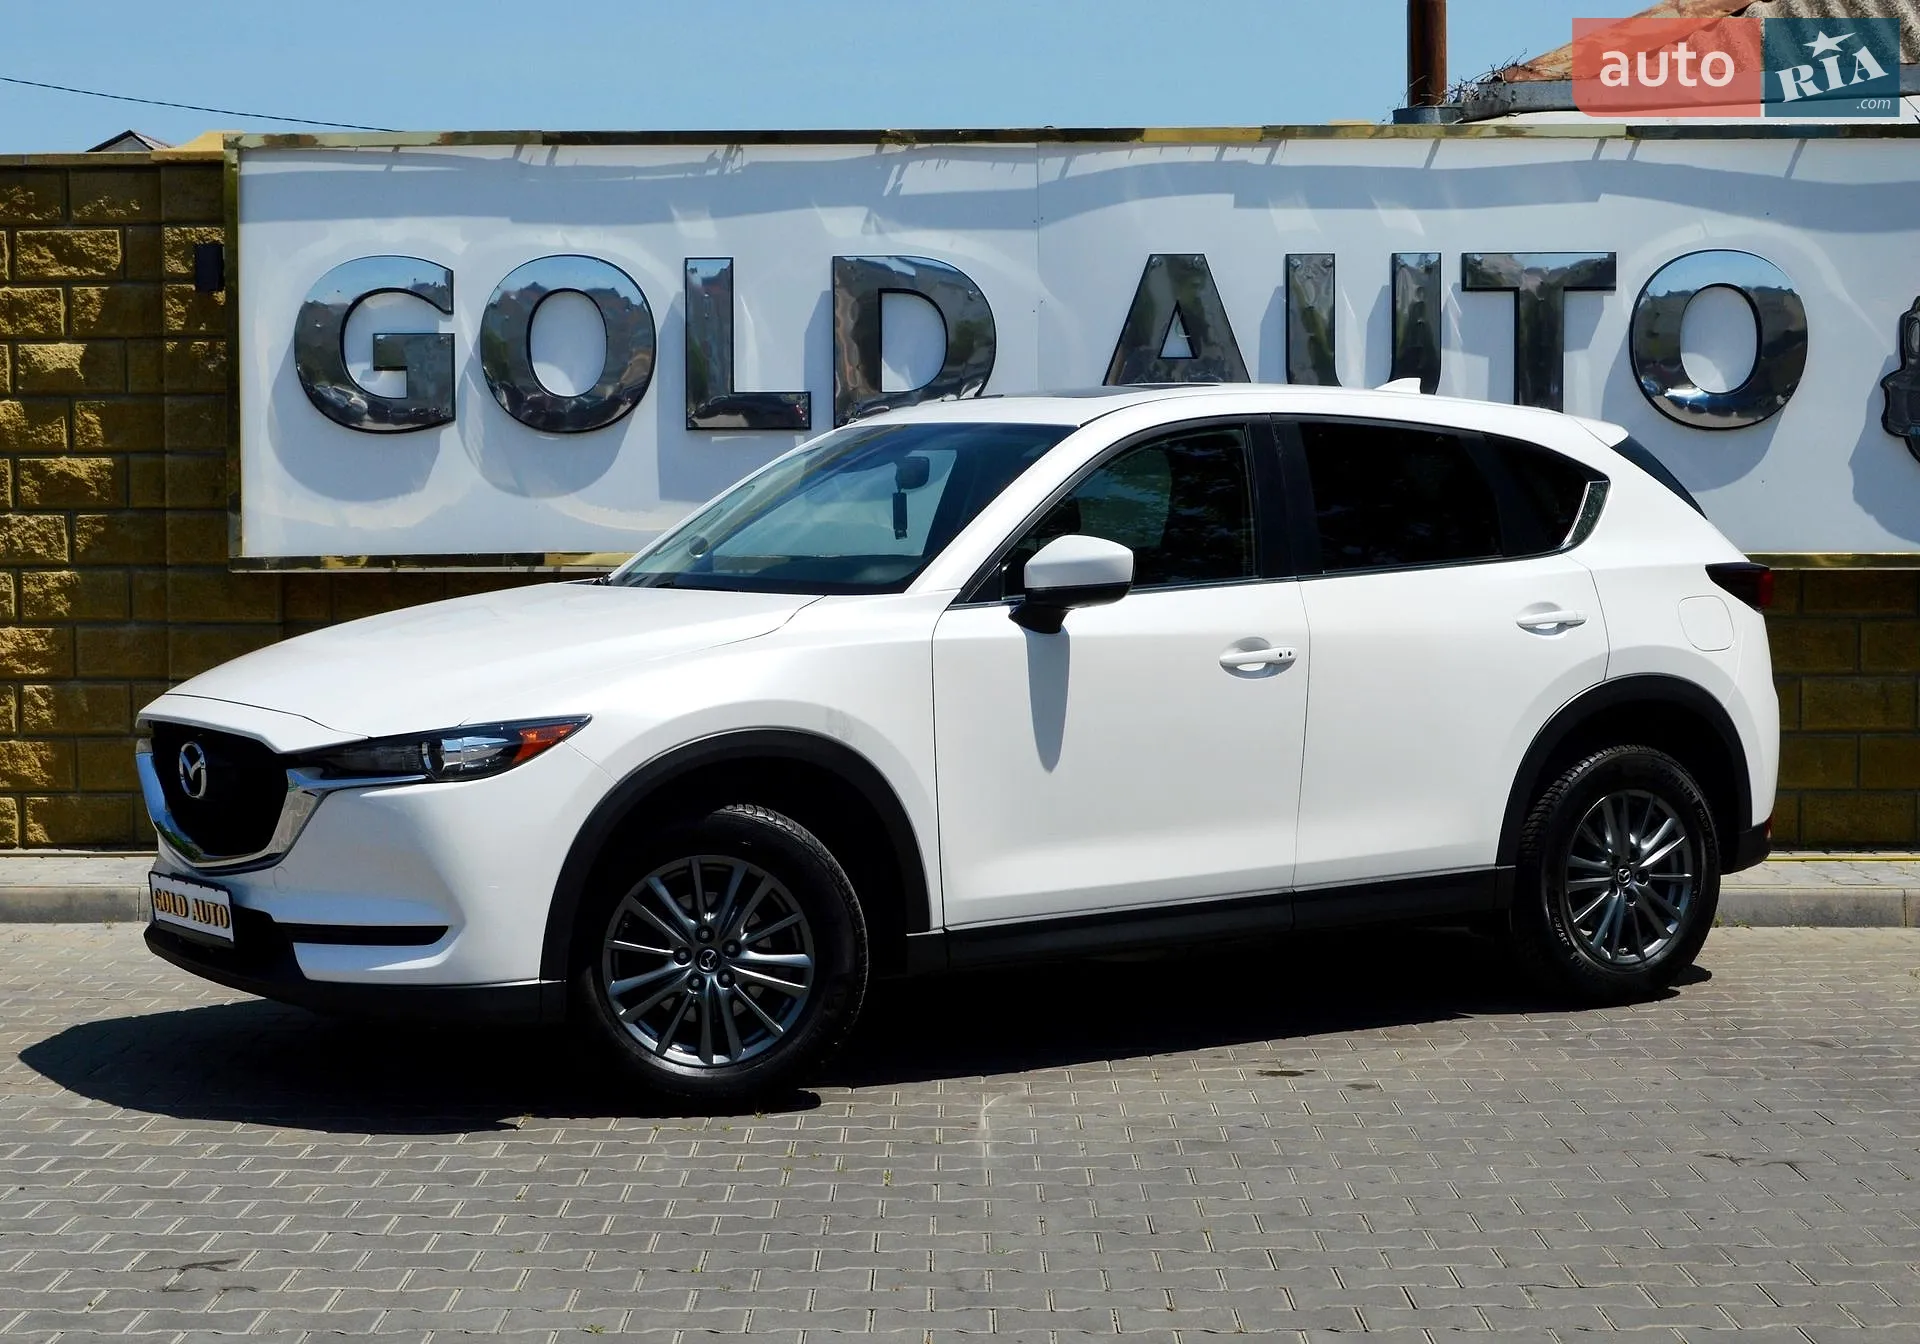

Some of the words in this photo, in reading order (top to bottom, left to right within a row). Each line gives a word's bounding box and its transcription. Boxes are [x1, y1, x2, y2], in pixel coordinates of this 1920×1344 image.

[294, 254, 997, 434] GOLD
[1102, 249, 1809, 431] AUTO
[153, 888, 188, 917] GOLD
[192, 898, 230, 929] AUTO
